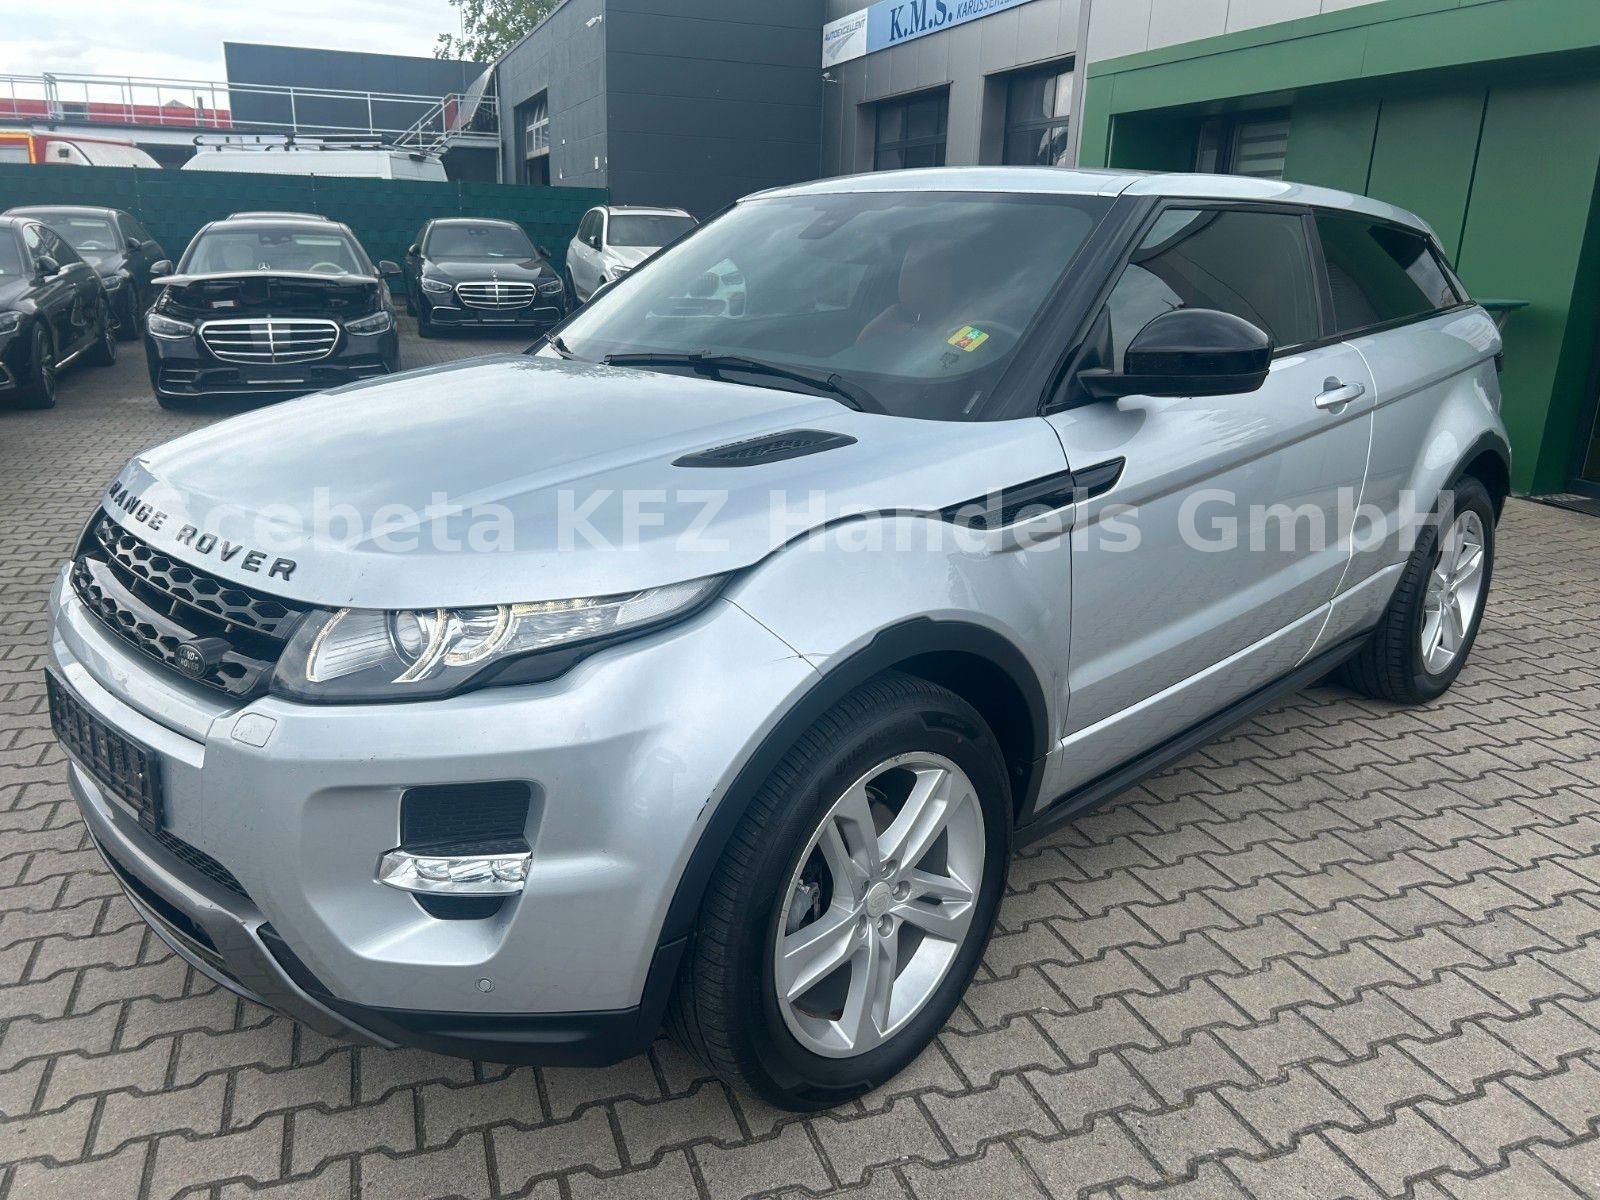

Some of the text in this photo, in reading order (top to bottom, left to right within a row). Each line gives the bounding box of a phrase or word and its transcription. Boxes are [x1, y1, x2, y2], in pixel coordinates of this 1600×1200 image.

[889, 0, 953, 42] K.M.S.
[107, 480, 297, 581] RANGE ROVER
